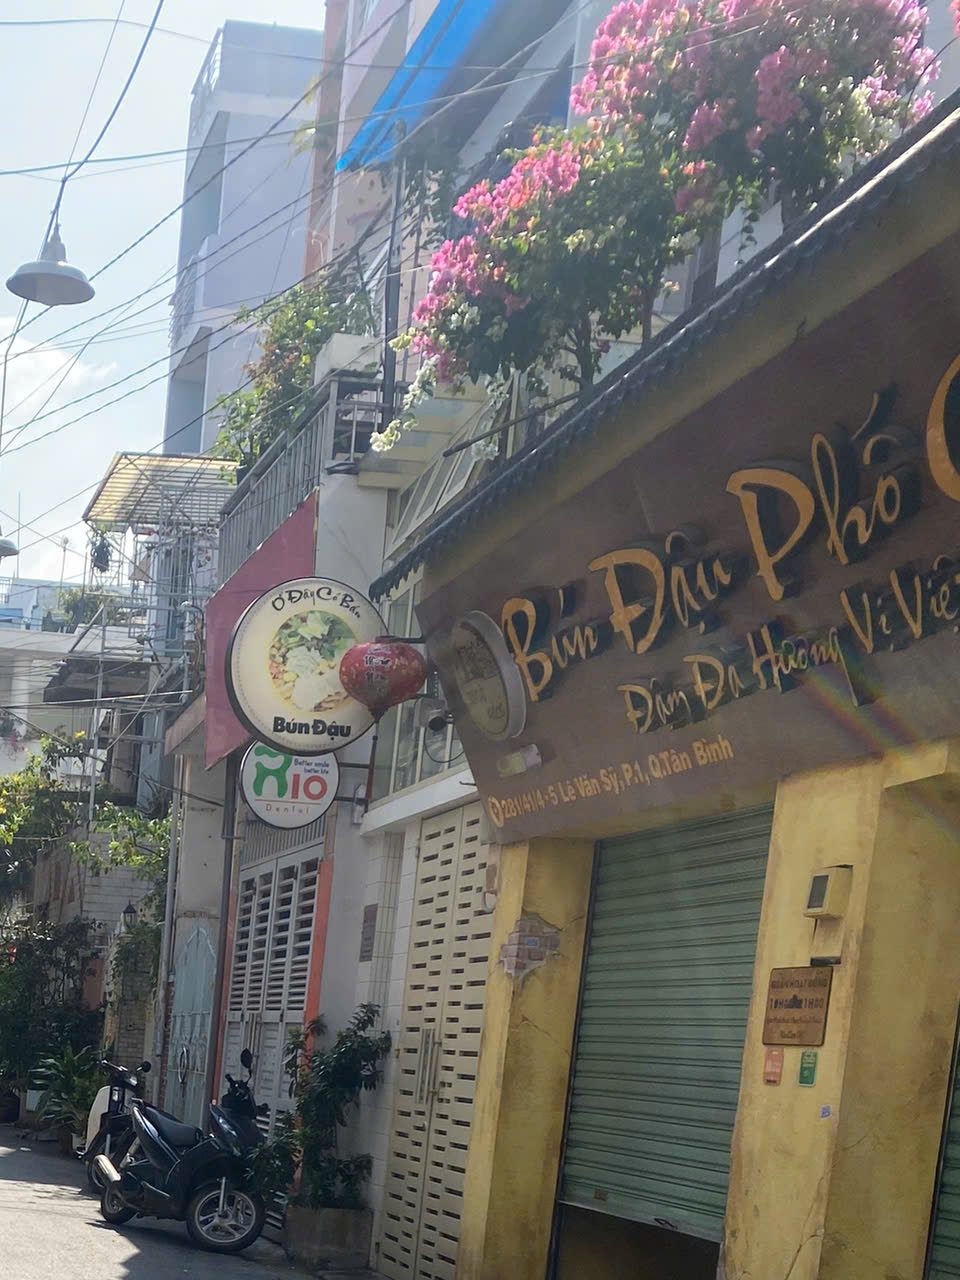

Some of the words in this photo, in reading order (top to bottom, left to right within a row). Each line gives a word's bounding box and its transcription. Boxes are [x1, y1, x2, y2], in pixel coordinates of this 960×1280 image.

[502, 588, 599, 702] Bún
[587, 530, 731, 655] Đậu
[725, 393, 901, 601] Phố
[285, 588, 315, 606] Đây
[316, 586, 341, 601] Có
[339, 593, 361, 618] Bán
[840, 590, 895, 654] Vị
[889, 554, 960, 641] Việ
[273, 716, 310, 735] Bún
[311, 718, 351, 741] Đậu
[576, 774, 601, 799] Văn
[693, 734, 734, 767] Bình
